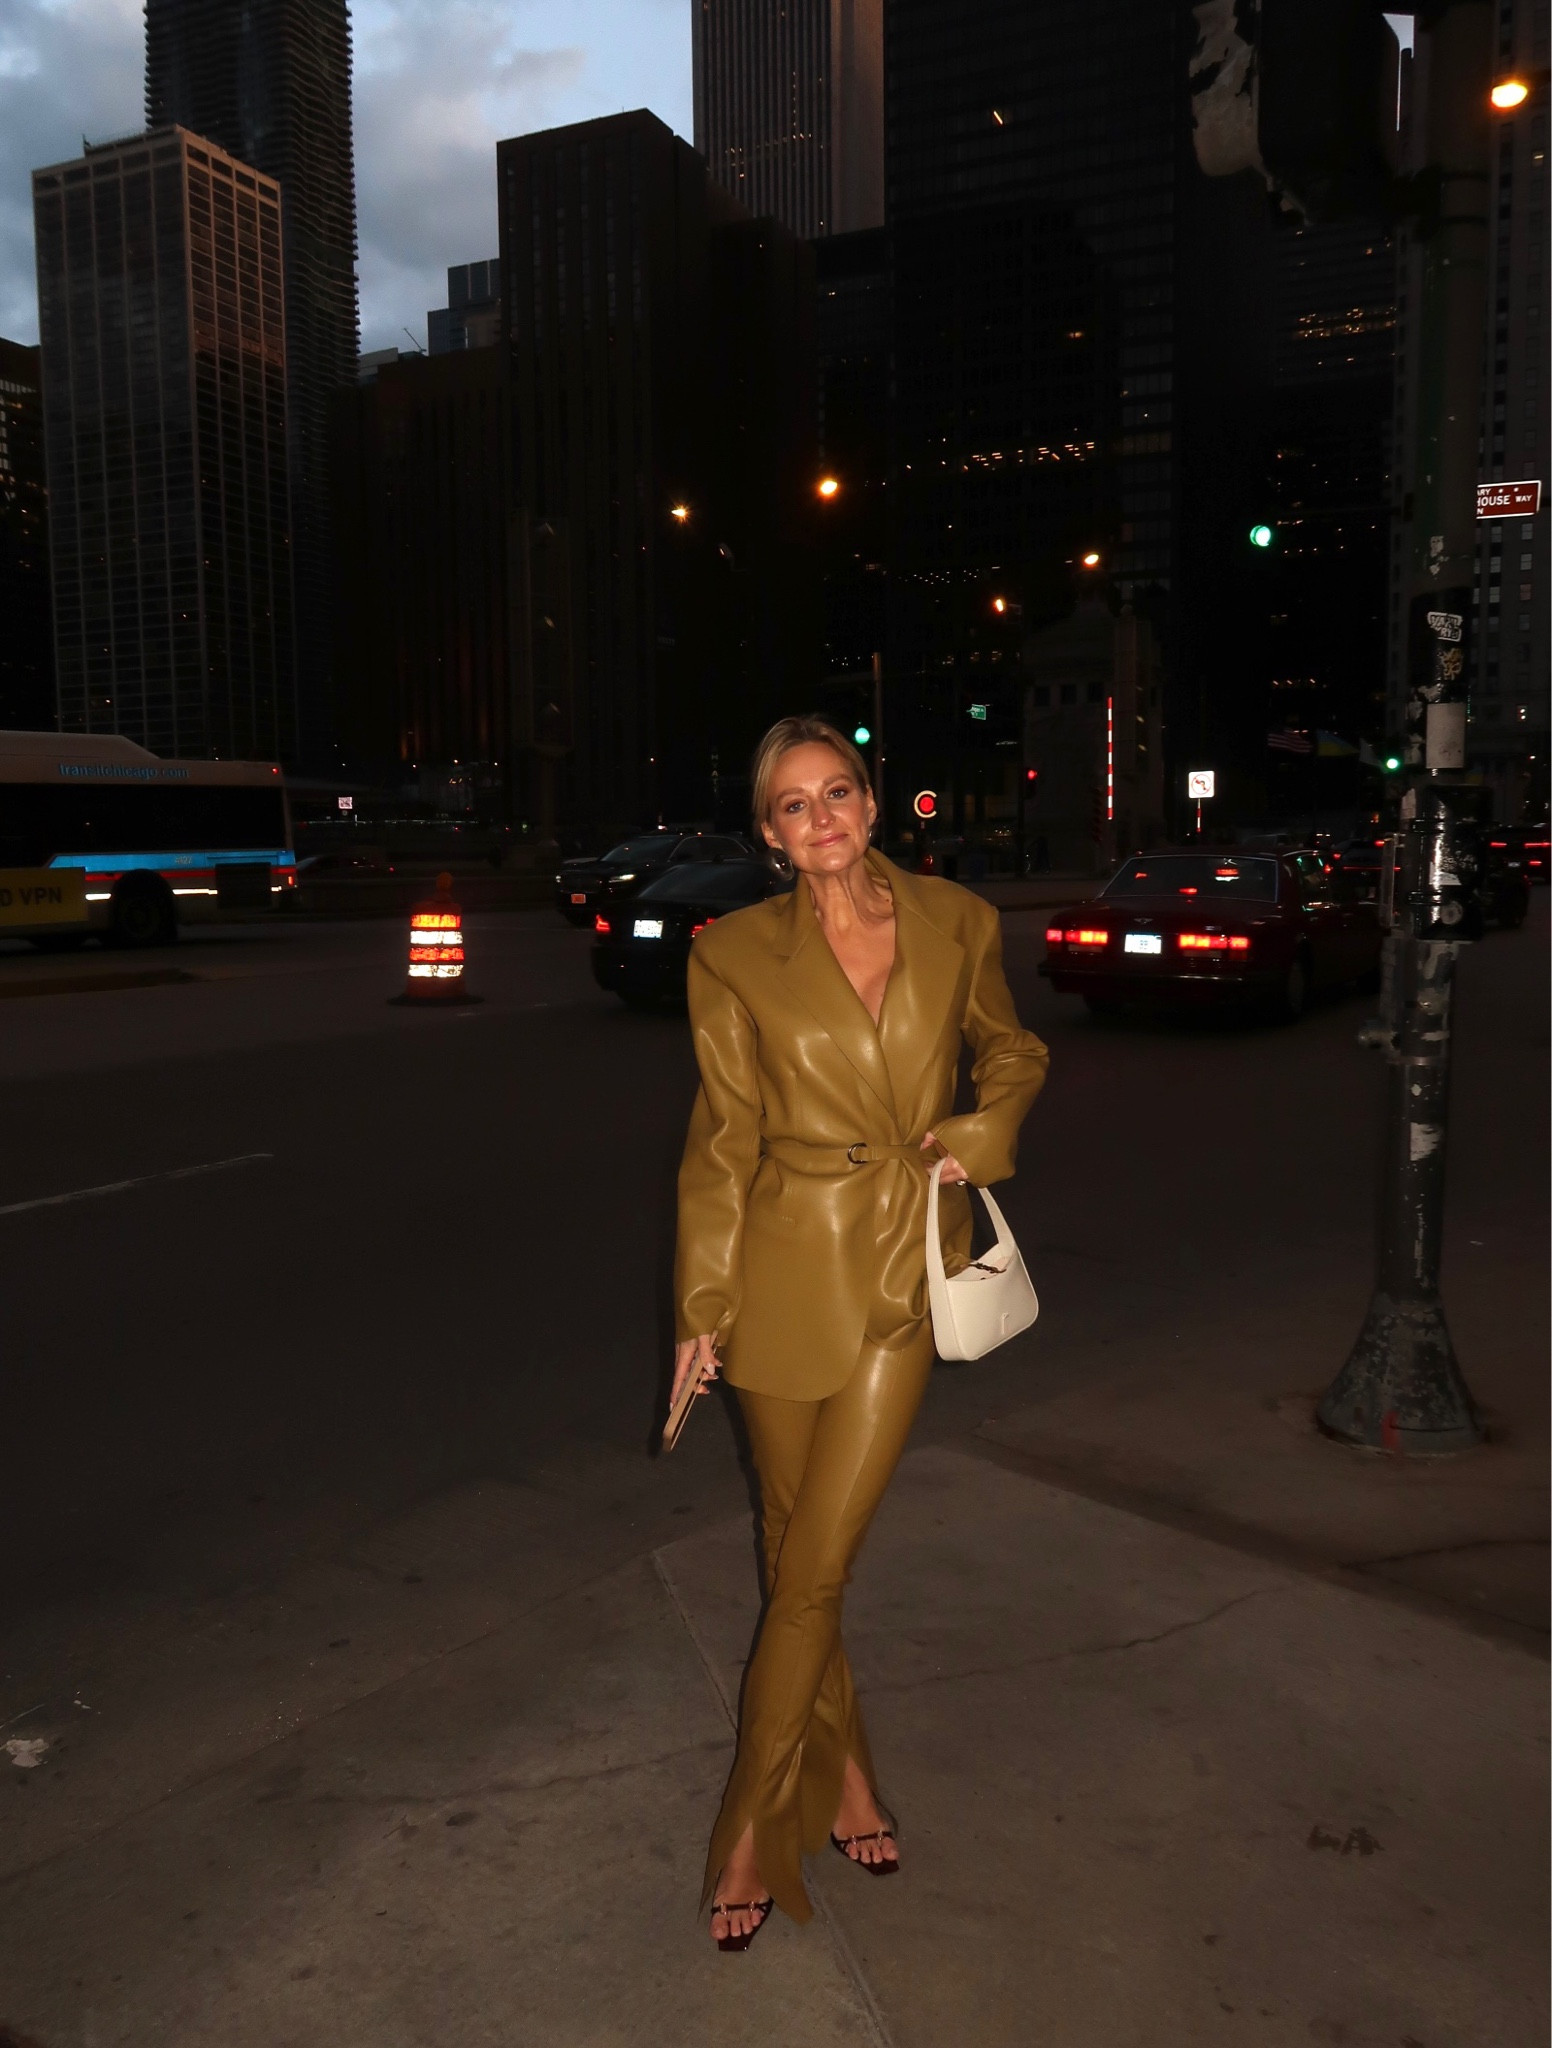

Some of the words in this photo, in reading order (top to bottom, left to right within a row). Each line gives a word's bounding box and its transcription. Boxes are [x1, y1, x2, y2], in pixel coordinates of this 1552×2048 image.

[1515, 495, 1533, 503] WAY
[58, 763, 190, 780] transitchicago.com
[18, 886, 62, 906] VPN
